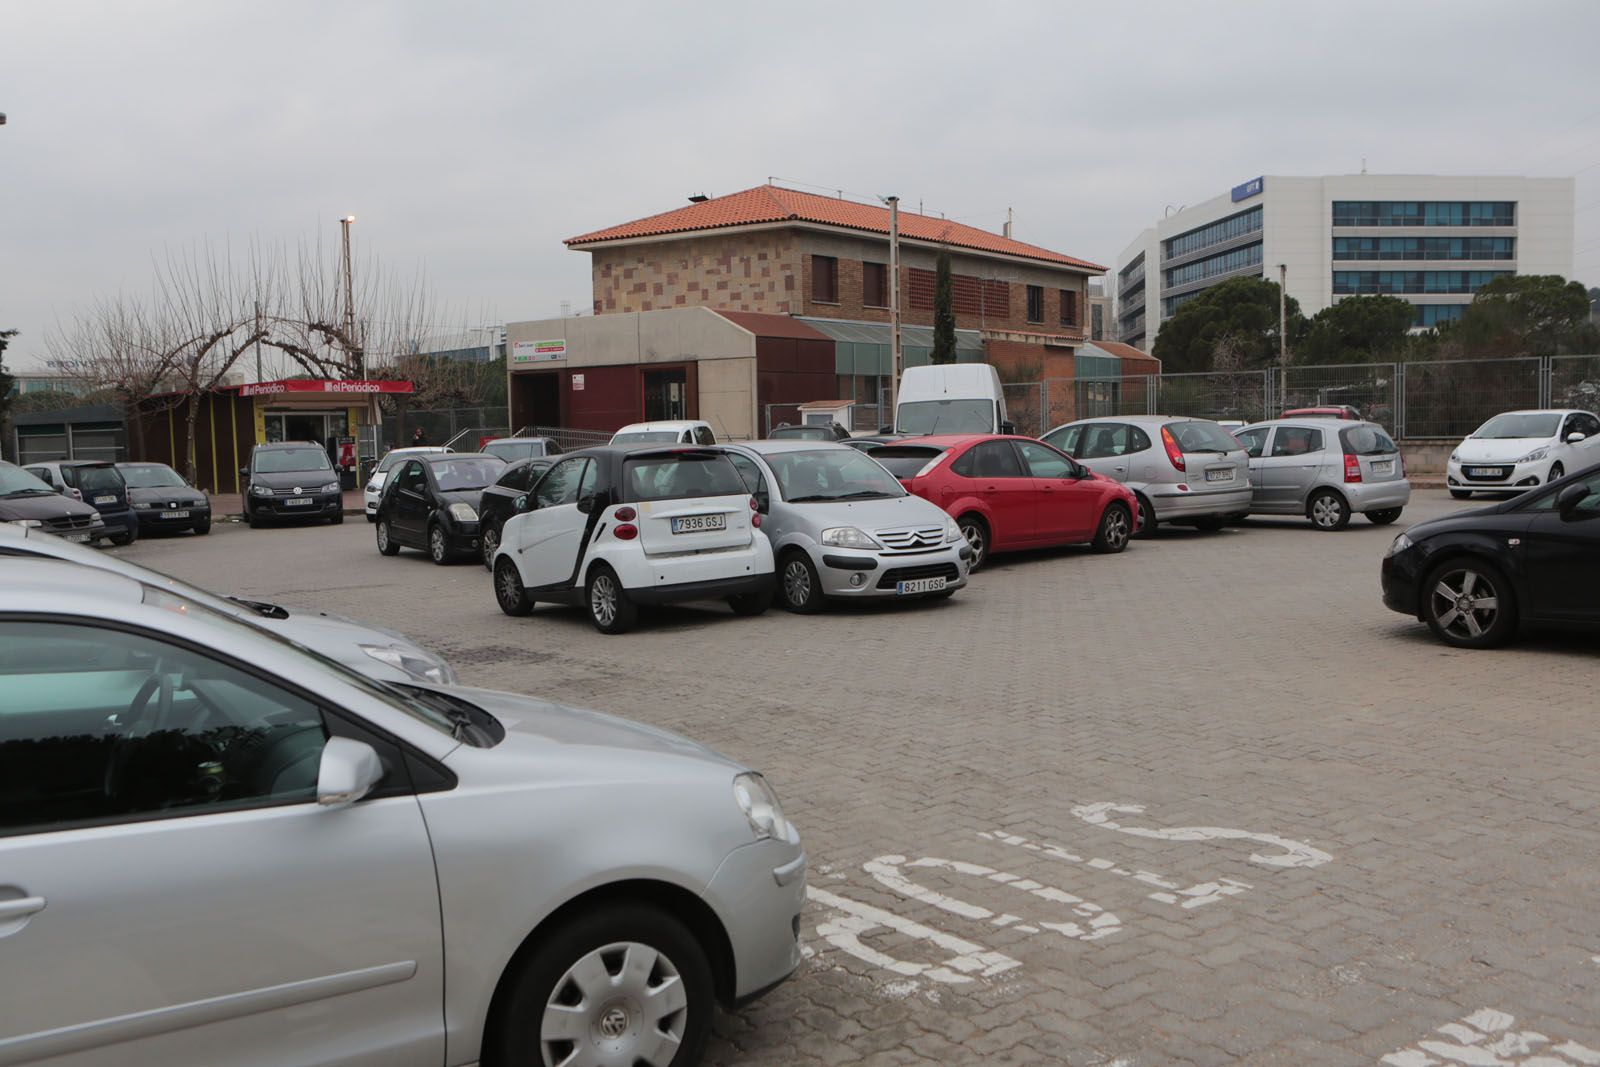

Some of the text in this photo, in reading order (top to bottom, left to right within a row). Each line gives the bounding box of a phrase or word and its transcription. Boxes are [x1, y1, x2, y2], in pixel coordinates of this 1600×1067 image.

[341, 382, 380, 392] Periódico
[678, 516, 723, 530] 7936 GSJ
[904, 578, 944, 592] 8211 GSG
[805, 801, 1333, 985] STOP
